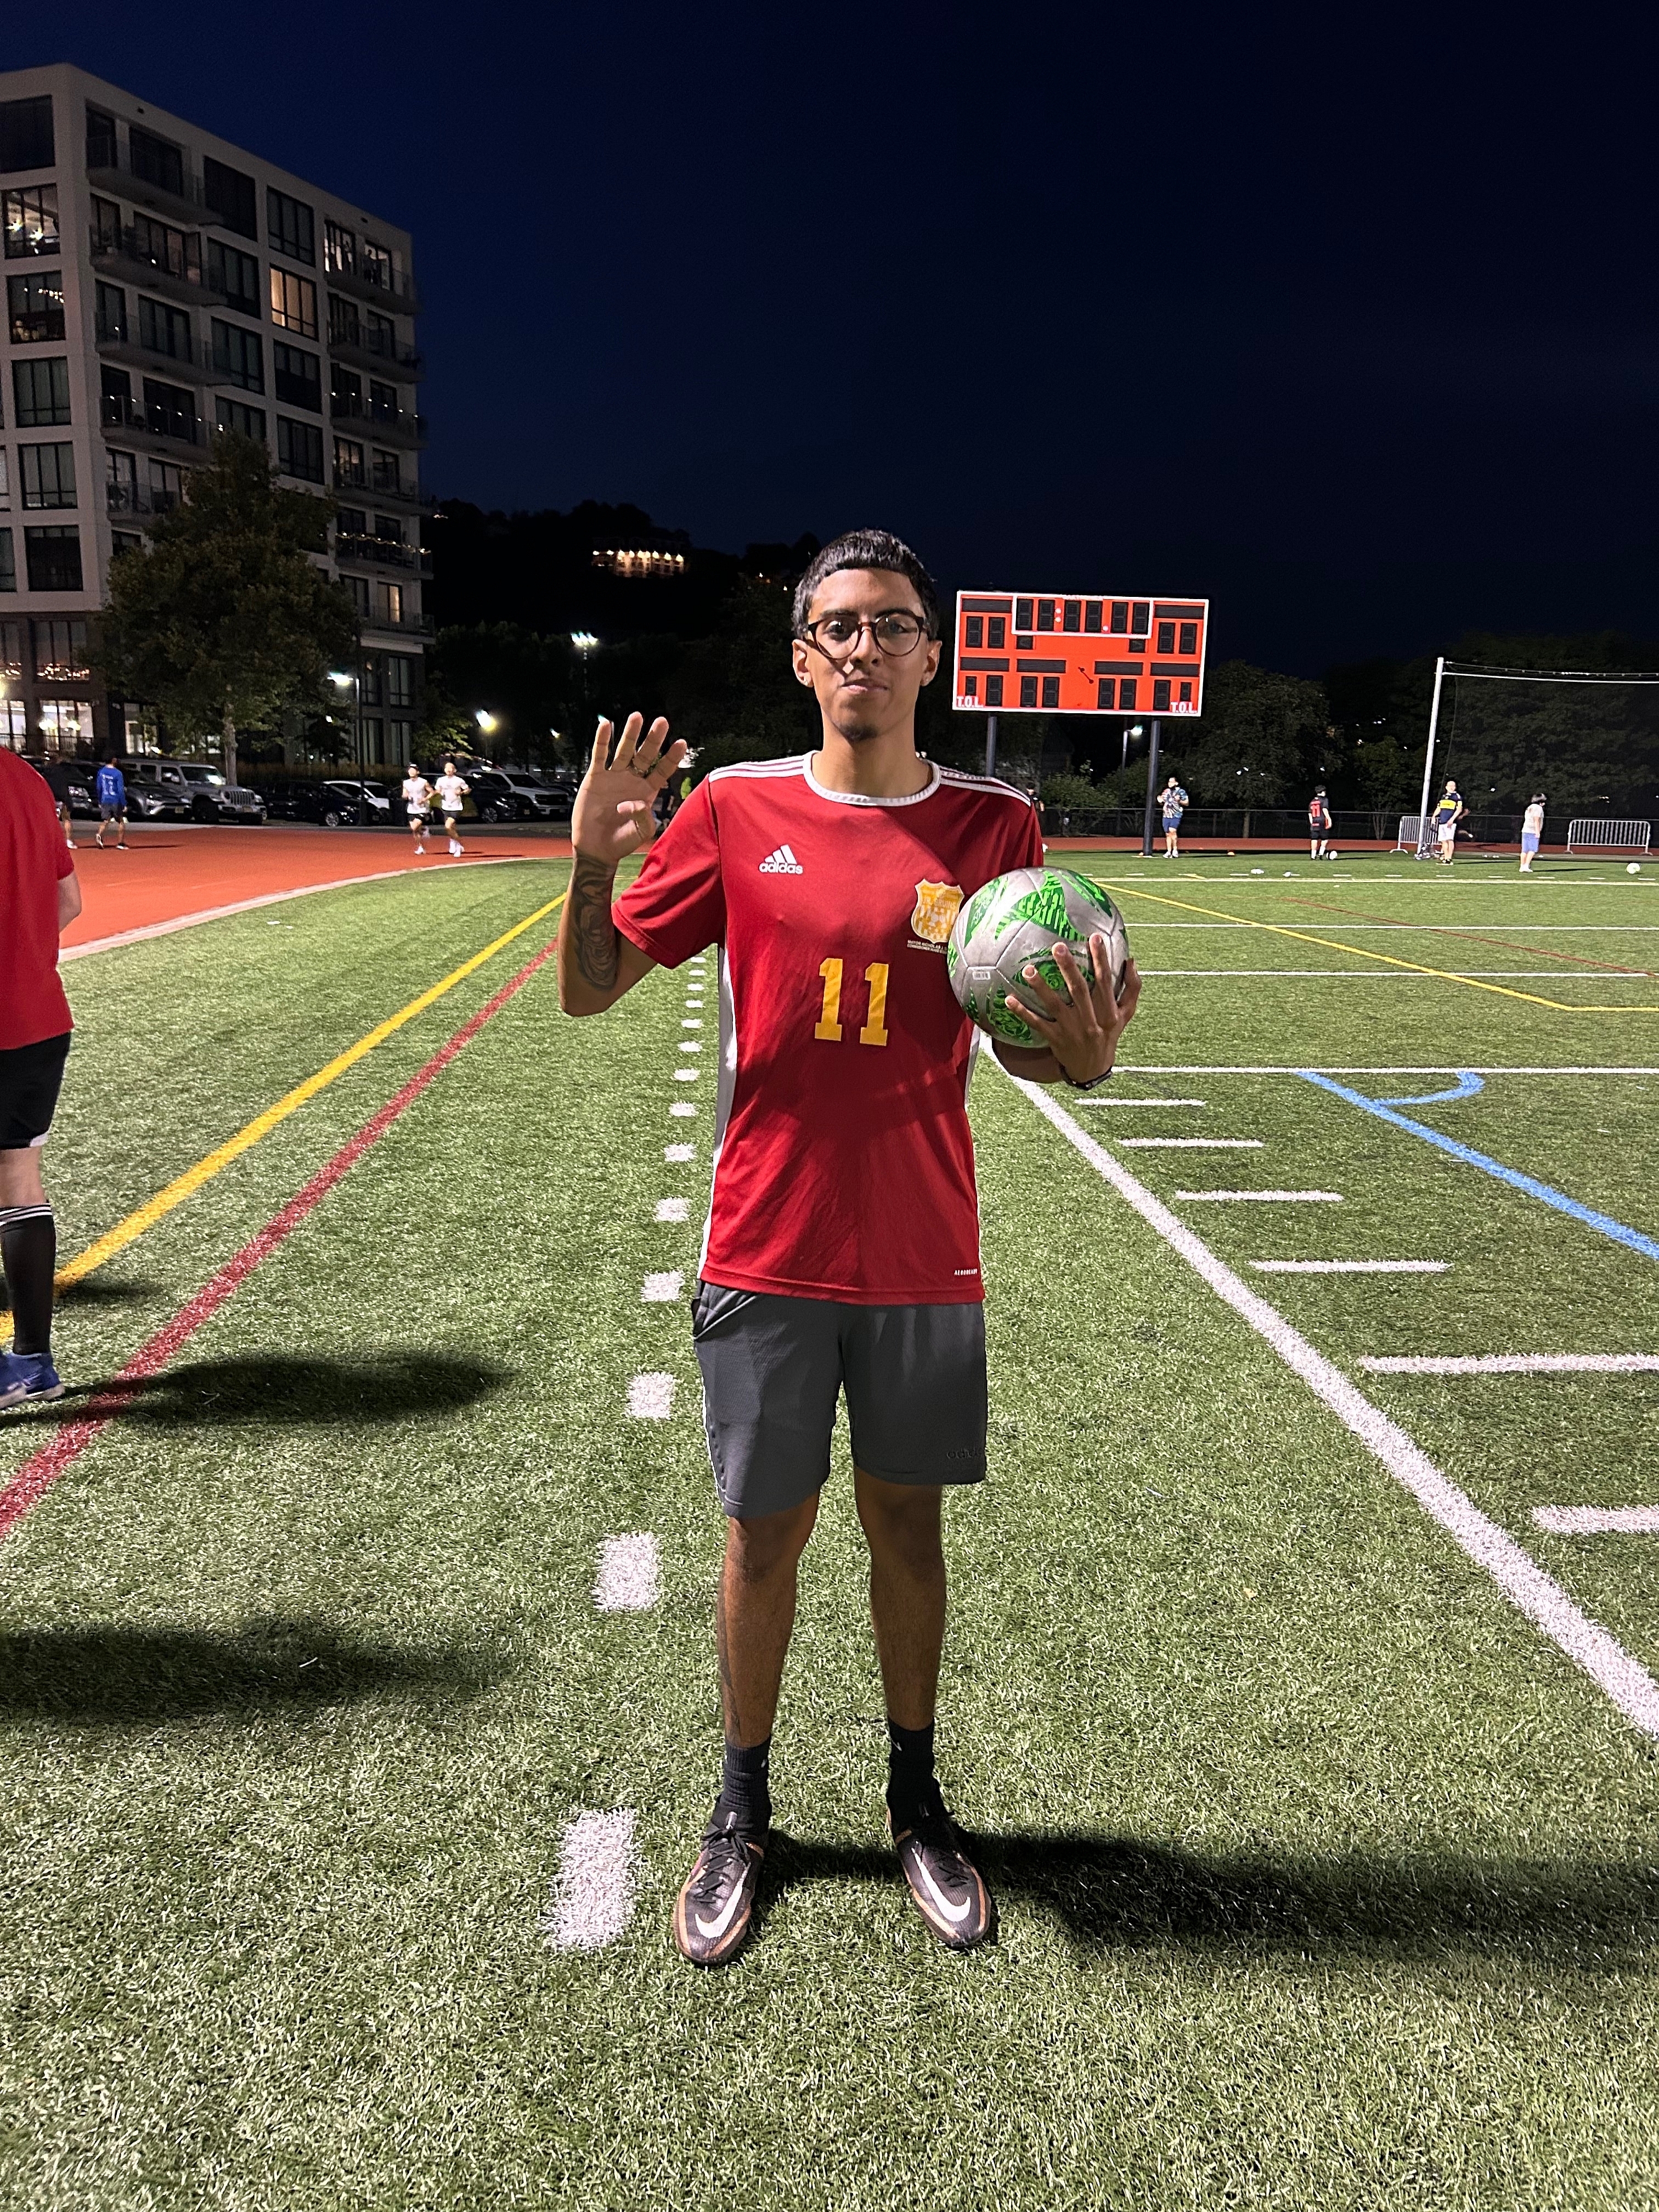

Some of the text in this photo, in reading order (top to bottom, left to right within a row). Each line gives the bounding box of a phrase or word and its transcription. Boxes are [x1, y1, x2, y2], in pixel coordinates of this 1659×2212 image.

[956, 696, 984, 708] T.O.L.
[1170, 701, 1198, 714] T.O.L.
[759, 862, 803, 874] adidas
[815, 957, 889, 1046] 11
